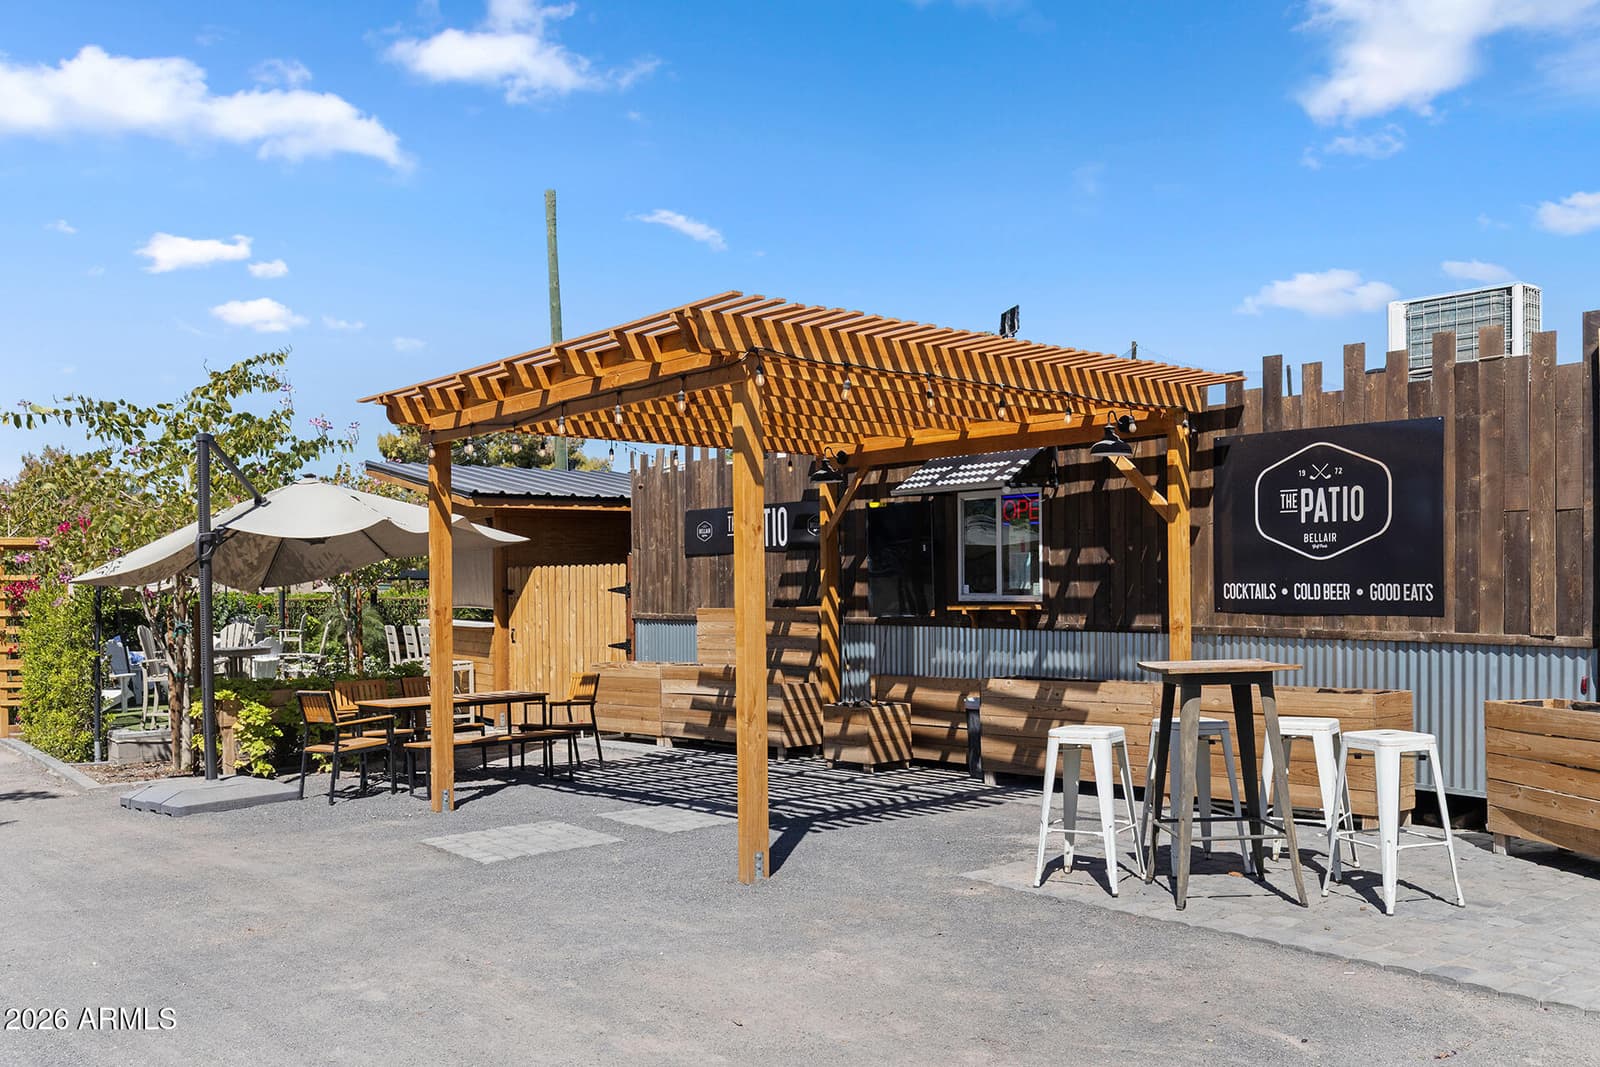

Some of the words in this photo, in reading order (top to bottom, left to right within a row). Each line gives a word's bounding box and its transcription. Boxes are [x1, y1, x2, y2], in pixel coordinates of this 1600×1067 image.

[1003, 499, 1040, 521] OPE
[1280, 492, 1298, 509] THE
[1300, 485, 1364, 523] PATIO
[764, 507, 788, 546] TIO
[1303, 532, 1337, 543] BELLAIR
[1223, 582, 1276, 600] COCKTAILS
[1294, 583, 1321, 600] COLD
[1323, 583, 1350, 600] BEER
[1370, 583, 1400, 601] GOOD
[1403, 584, 1434, 601] EATS
